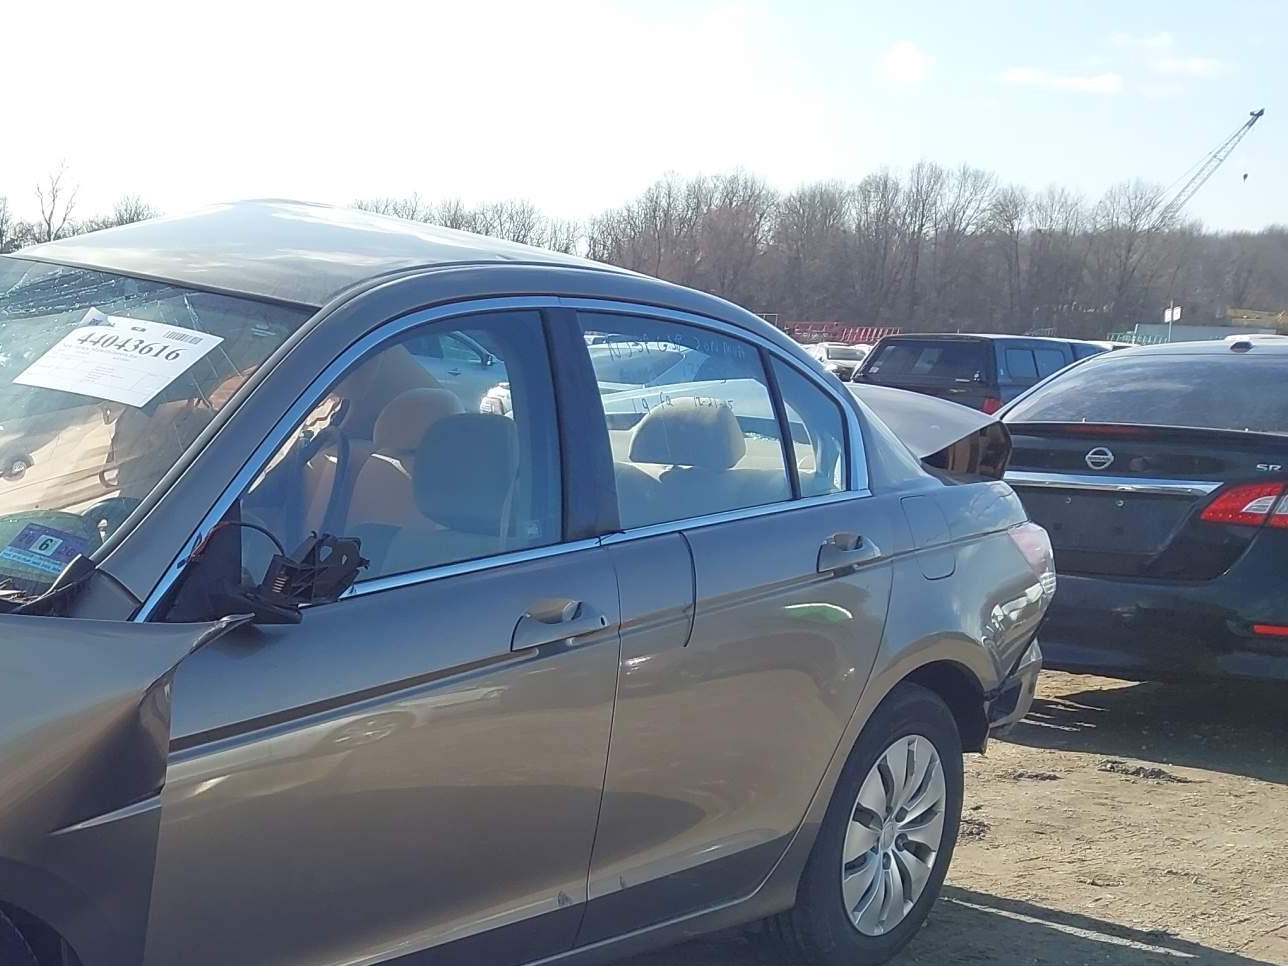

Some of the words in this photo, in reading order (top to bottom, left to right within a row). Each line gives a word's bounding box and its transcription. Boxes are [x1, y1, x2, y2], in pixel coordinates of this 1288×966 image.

[77, 331, 186, 361] 44043616
[1255, 463, 1283, 472] SR
[38, 538, 54, 551] 6
